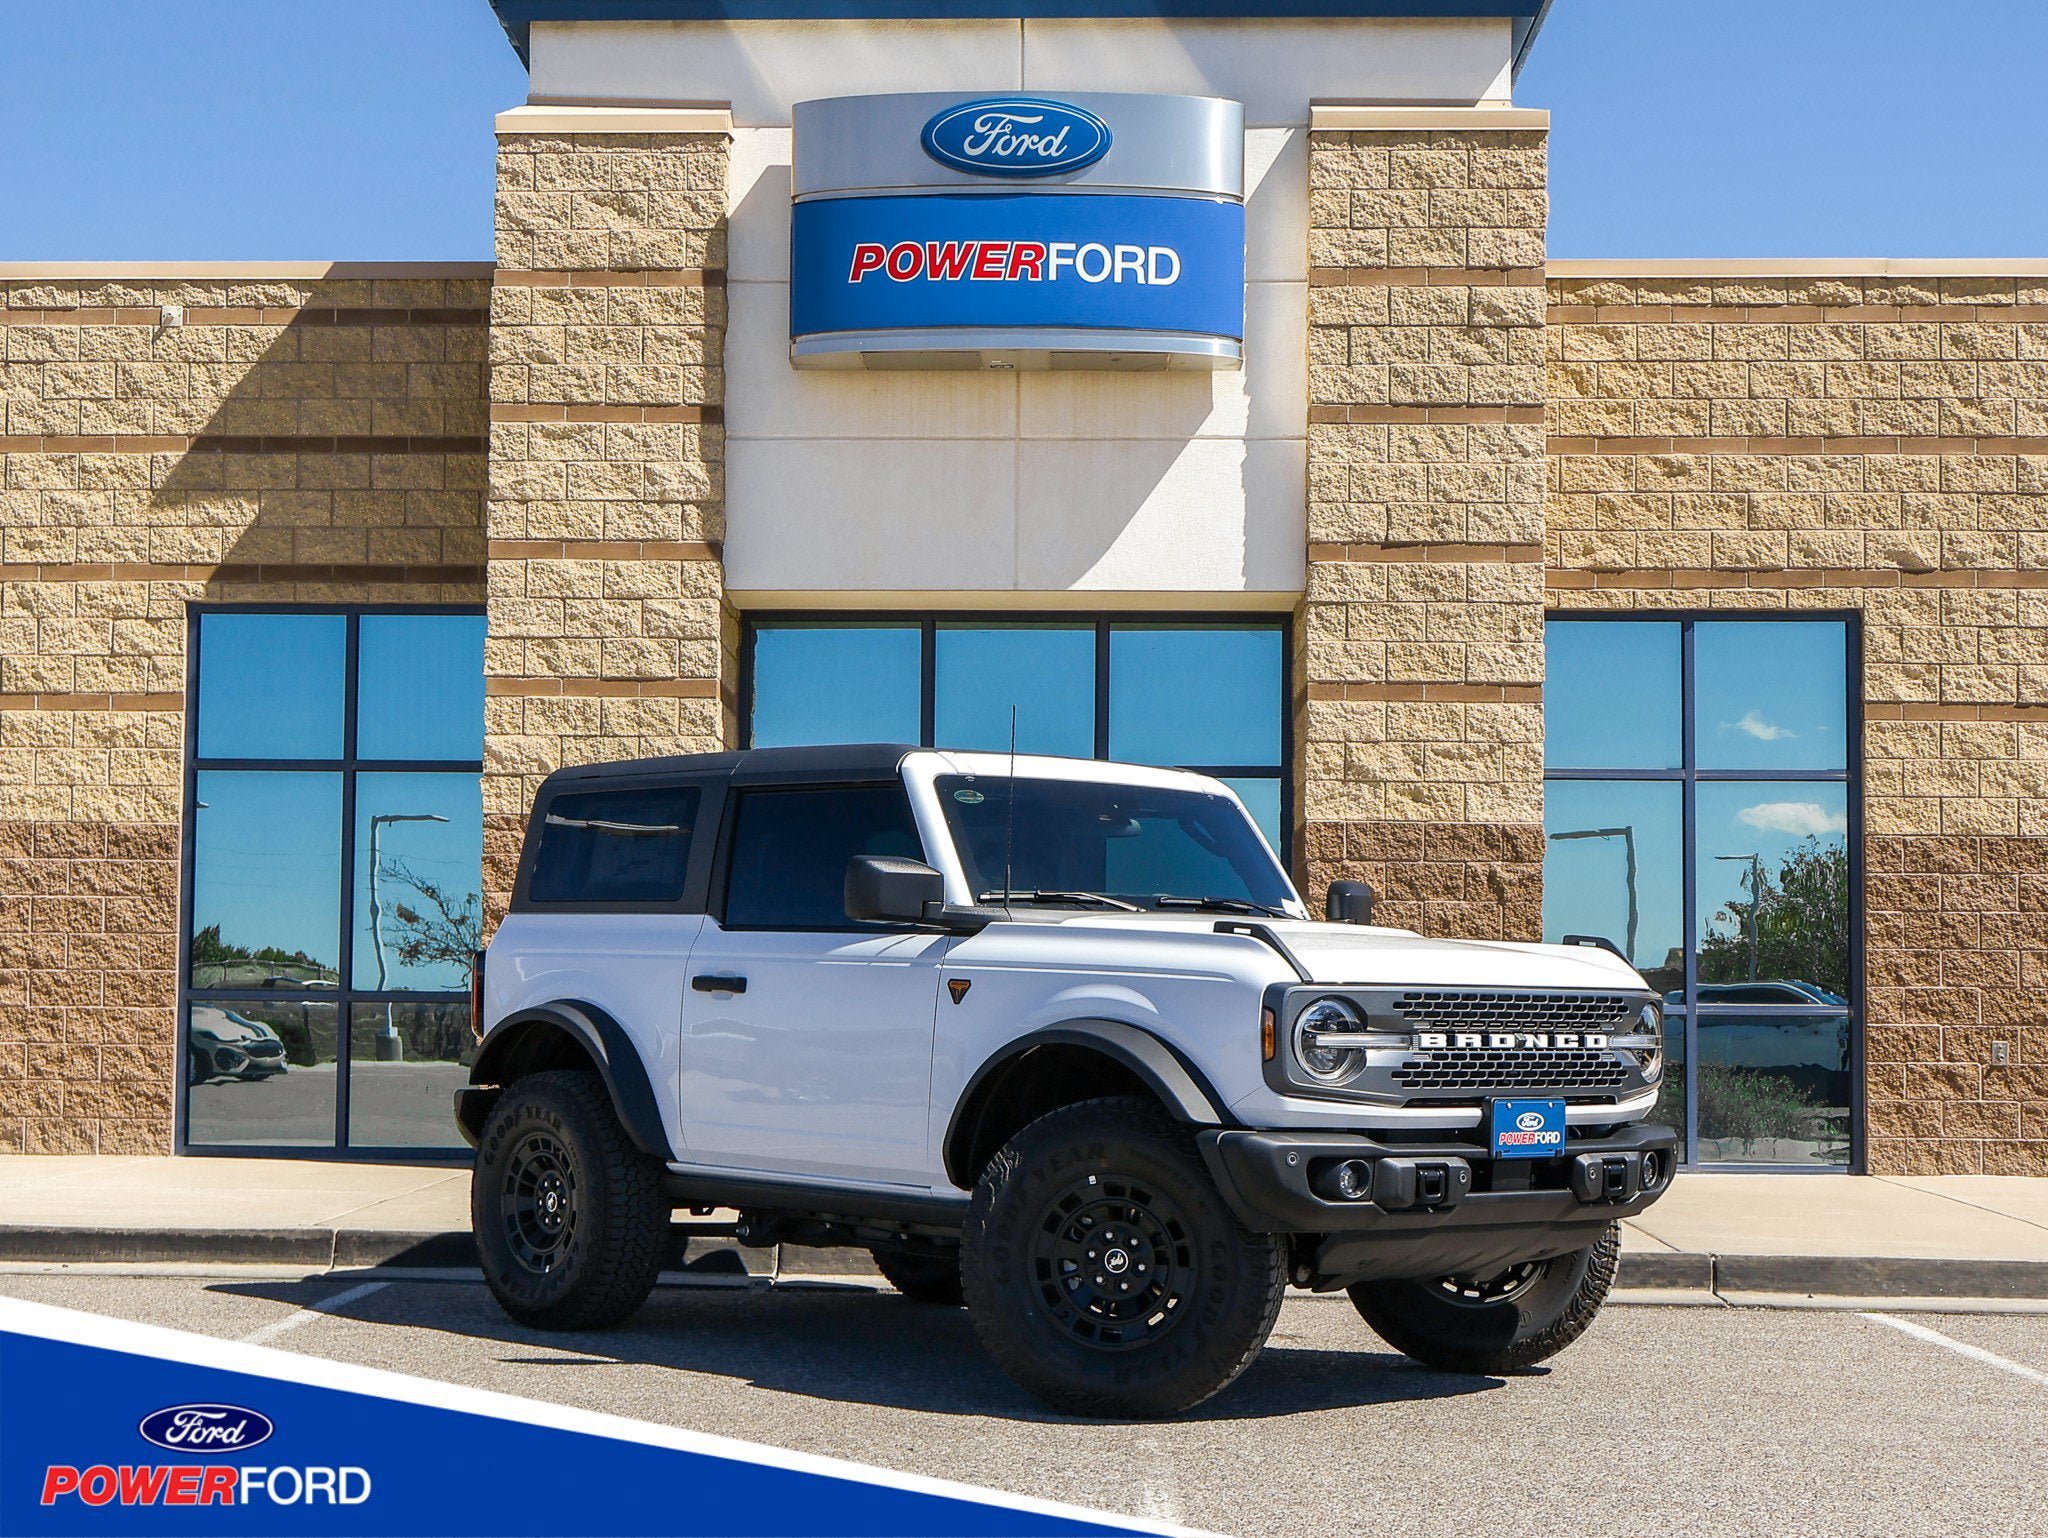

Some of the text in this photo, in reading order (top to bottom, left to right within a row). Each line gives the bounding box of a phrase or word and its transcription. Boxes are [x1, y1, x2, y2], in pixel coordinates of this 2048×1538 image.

[963, 112, 1069, 158] Ford
[848, 240, 1182, 287] POWERFORD
[1418, 1032, 1608, 1049] BRONCO
[1499, 1131, 1561, 1146] POWERFORD
